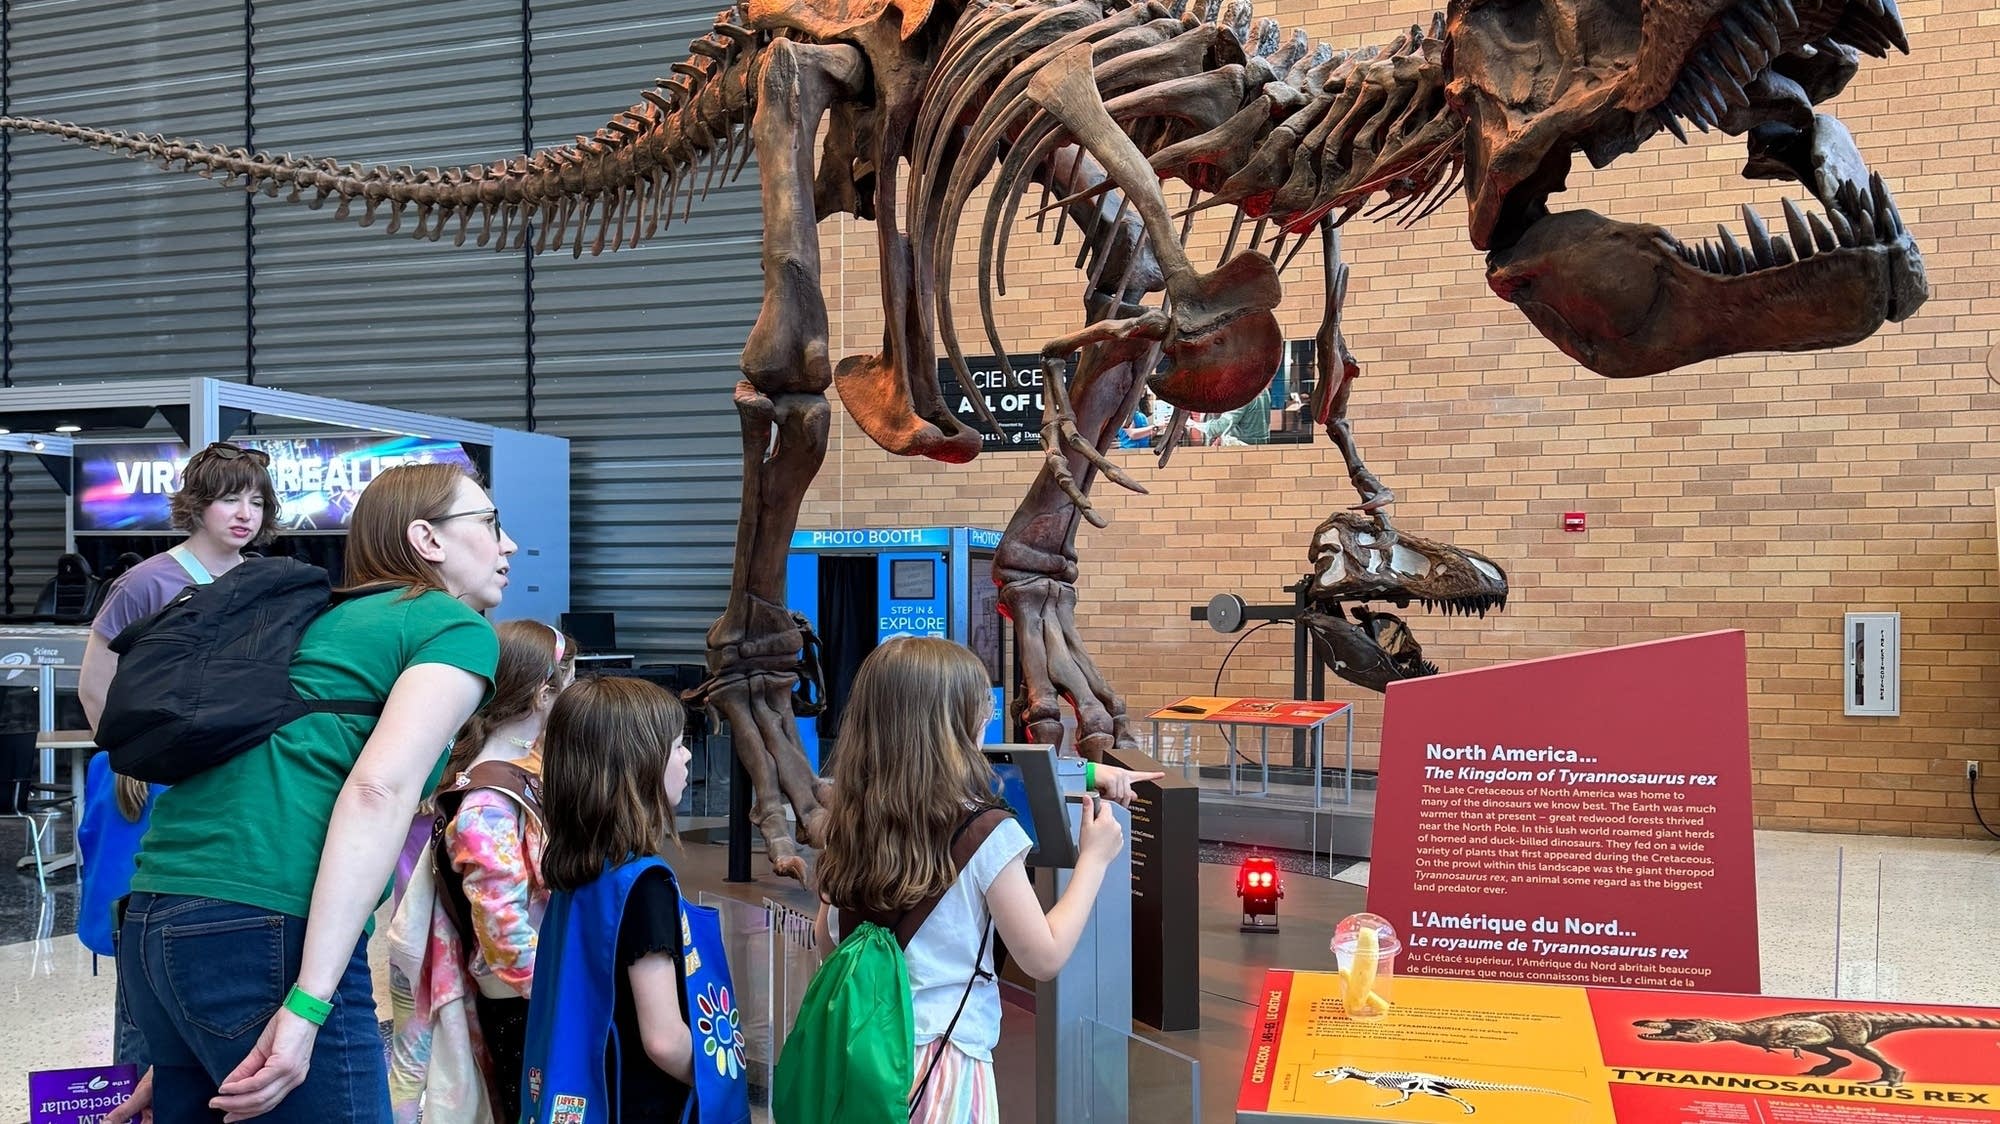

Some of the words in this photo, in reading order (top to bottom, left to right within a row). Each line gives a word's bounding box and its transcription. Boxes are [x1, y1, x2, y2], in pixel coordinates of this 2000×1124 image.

[959, 369, 1043, 388] CIECE
[958, 395, 996, 413] AL
[1001, 394, 1030, 411] OF
[813, 531, 864, 545] PHOTO
[869, 529, 922, 544] BOOTH
[891, 606, 914, 615] STEP
[915, 606, 925, 614] IN
[927, 606, 934, 614] &
[880, 617, 945, 630] EXPLORE
[33, 647, 59, 656] Science
[36, 656, 65, 664] Museum
[1426, 743, 1486, 760] North
[1424, 766, 1454, 779] The
[1457, 766, 1532, 783] Kingdom
[1536, 768, 1556, 781] of
[1558, 768, 1685, 785] Tyrannosaurus
[1688, 774, 1717, 785] rex
[1422, 784, 1441, 793] The
[1443, 785, 1464, 794] Late
[1466, 785, 1524, 796] Cretaceous
[1526, 787, 1537, 796] of
[1540, 787, 1570, 797] North
[1572, 788, 1615, 798] America
[1640, 790, 1671, 799] home
[1673, 791, 1685, 800] to
[1421, 798, 1448, 808] many
[1450, 798, 1461, 806] of
[1463, 798, 1480, 807] the
[1482, 798, 1531, 808] dinosaurs
[1533, 801, 1549, 809] we
[1551, 800, 1580, 809] know
[1582, 801, 1607, 810] best.
[1609, 801, 1630, 811] The
[1632, 802, 1660, 812] Earth
[1685, 804, 1716, 813] much
[1460, 810, 1483, 819] than
[1497, 813, 1536, 821] present
[1548, 814, 1576, 823] great
[1578, 813, 1625, 823] redwood
[1628, 814, 1664, 824] forests
[1666, 816, 1704, 825] thrived
[1443, 822, 1459, 831] the
[1462, 822, 1491, 831] North
[1494, 823, 1519, 832] Pole.
[1521, 824, 1531, 833] In
[1534, 824, 1553, 834] this
[1555, 825, 1577, 834] lush
[1579, 826, 1609, 835] world
[1612, 828, 1652, 837] roamed
[1655, 828, 1682, 839] giant
[1684, 829, 1714, 838] herds
[1417, 833, 1428, 842] of
[1430, 833, 1466, 843] horned
[1468, 835, 1487, 844] and
[1489, 835, 1548, 846] duck-billed
[1550, 837, 1603, 848] dinosaurs.
[1605, 839, 1632, 851] They
[1634, 840, 1651, 849] fed
[1653, 842, 1667, 850] on
[1678, 841, 1704, 851] wide
[1416, 845, 1450, 857] variety
[1452, 847, 1463, 855] of
[1465, 847, 1496, 857] plants
[1498, 848, 1519, 857] that
[1521, 849, 1541, 858] first
[1543, 851, 1592, 861] appeared
[1594, 851, 1628, 863] during
[1631, 853, 1648, 862] the
[1651, 853, 1714, 864] Cretaceous.
[1415, 857, 1430, 866] On
[1433, 858, 1449, 867] the
[1452, 860, 1481, 869] prowl
[1483, 860, 1515, 869] within
[1517, 861, 1536, 870] this
[1538, 862, 1590, 874] landscape
[1615, 864, 1633, 874] the
[1635, 865, 1662, 876] giant
[1664, 866, 1714, 878] theropod
[1413, 882, 1435, 891] land
[1437, 883, 1481, 893] predator
[1483, 886, 1507, 894] ever.
[1415, 869, 1487, 881] Tyrannosaurus
[1489, 874, 1508, 882] rex,
[1525, 874, 1560, 883] animal
[1562, 877, 1590, 885] some
[1593, 877, 1627, 888] regard
[1629, 879, 1641, 887] as
[1643, 878, 1661, 887] the
[1663, 879, 1702, 890] biggest
[1531, 916, 1558, 933] du
[1409, 933, 1428, 946] Le
[1431, 937, 1503, 951] royaume
[1506, 937, 1527, 951] de
[1531, 939, 1657, 957] Tyrannosaurus
[1660, 948, 1689, 959] rex
[1407, 952, 1421, 961] Au
[1423, 952, 1462, 963] Crétacé
[1464, 955, 1514, 966] supérieur,
[1573, 960, 1587, 969] du
[1590, 960, 1616, 970] Nord
[1618, 962, 1656, 972] abritait
[1658, 964, 1711, 976] beaucoup
[1406, 964, 1419, 973] de
[1421, 965, 1475, 976] dinosaures
[1477, 969, 1497, 978] que
[1499, 970, 1524, 978] nous
[1526, 972, 1589, 982] connaissons
[1592, 973, 1617, 983] bien.
[1620, 975, 1632, 984] Le
[1634, 975, 1667, 986] climat
[1669, 977, 1683, 986] de
[1685, 978, 1694, 987] la
[1251, 1045, 1271, 1084] CRETACEOUS
[1611, 1069, 1915, 1100] TYRANNOSAURUS
[1924, 1090, 1989, 1104] REX
